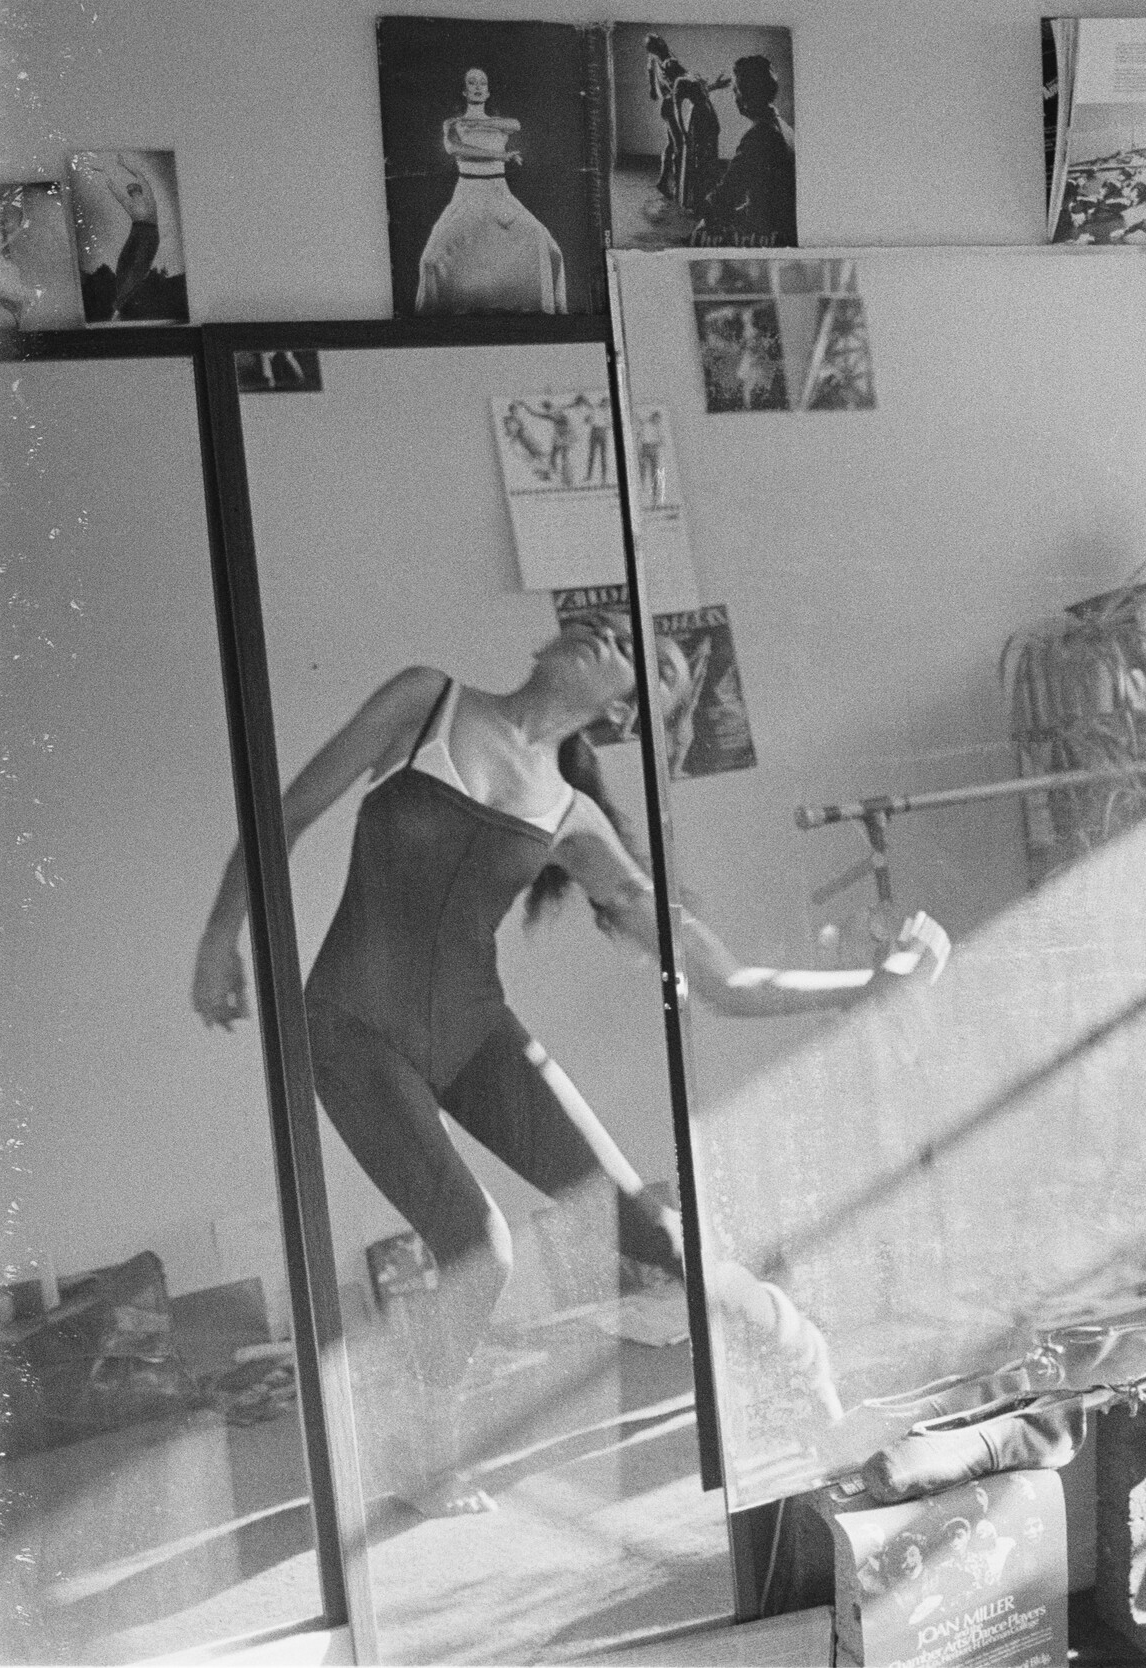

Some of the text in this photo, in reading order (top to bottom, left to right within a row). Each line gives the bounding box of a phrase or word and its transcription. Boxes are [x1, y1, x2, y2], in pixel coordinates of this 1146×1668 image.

[917, 1616, 960, 1650] JOAN
[963, 1595, 1016, 1628] MILLER
[1008, 1605, 1047, 1628] Players
